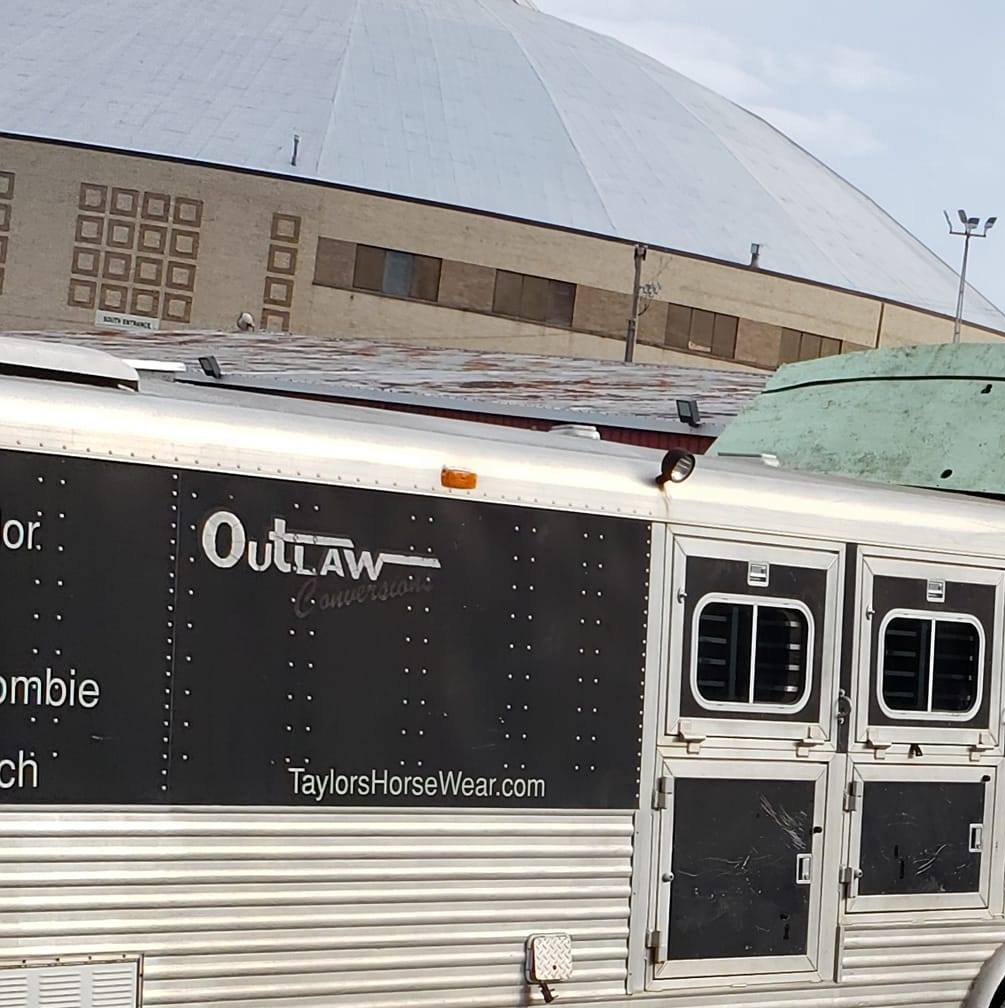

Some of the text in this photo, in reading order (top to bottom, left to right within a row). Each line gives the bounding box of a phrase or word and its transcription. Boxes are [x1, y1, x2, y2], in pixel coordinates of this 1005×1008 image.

[103, 315, 151, 330] SOUTH ENTRANCE
[288, 767, 546, 802] TaylorsHorseWear.com
